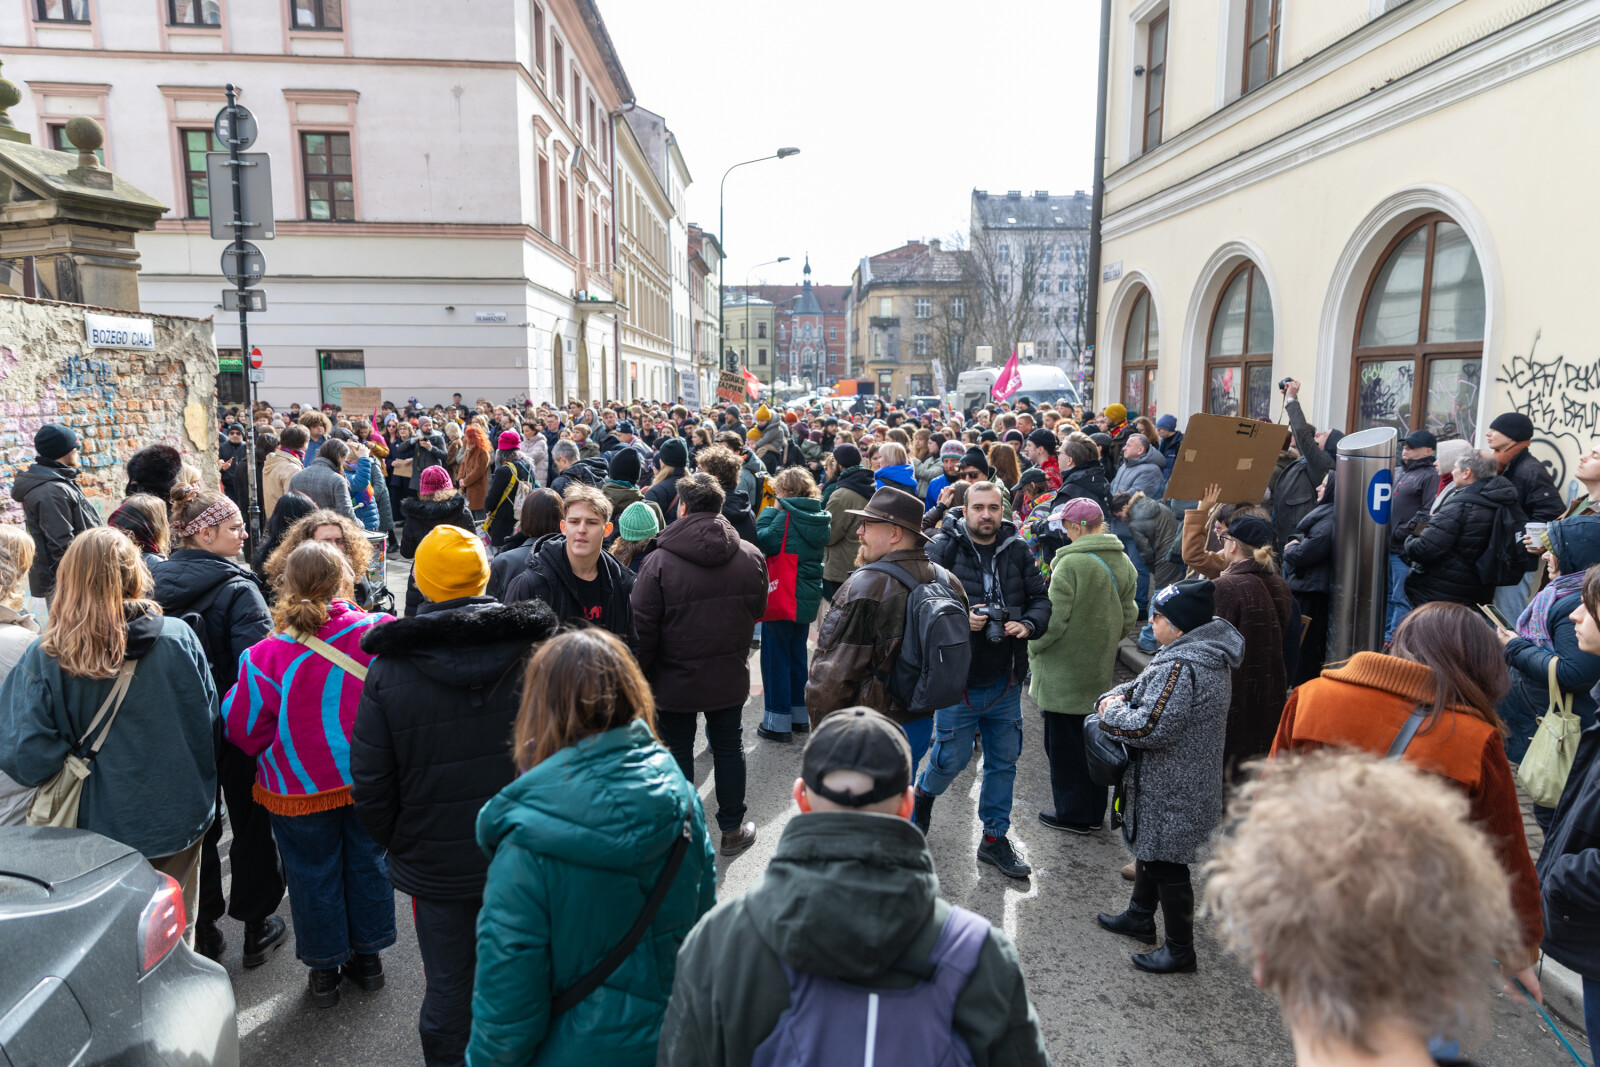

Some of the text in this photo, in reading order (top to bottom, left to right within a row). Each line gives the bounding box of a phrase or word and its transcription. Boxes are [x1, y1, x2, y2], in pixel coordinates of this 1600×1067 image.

[92, 327, 153, 347] BOŻEGO CIAŁA
[1373, 482, 1392, 511] P
[1165, 669, 1179, 692] DANCE
